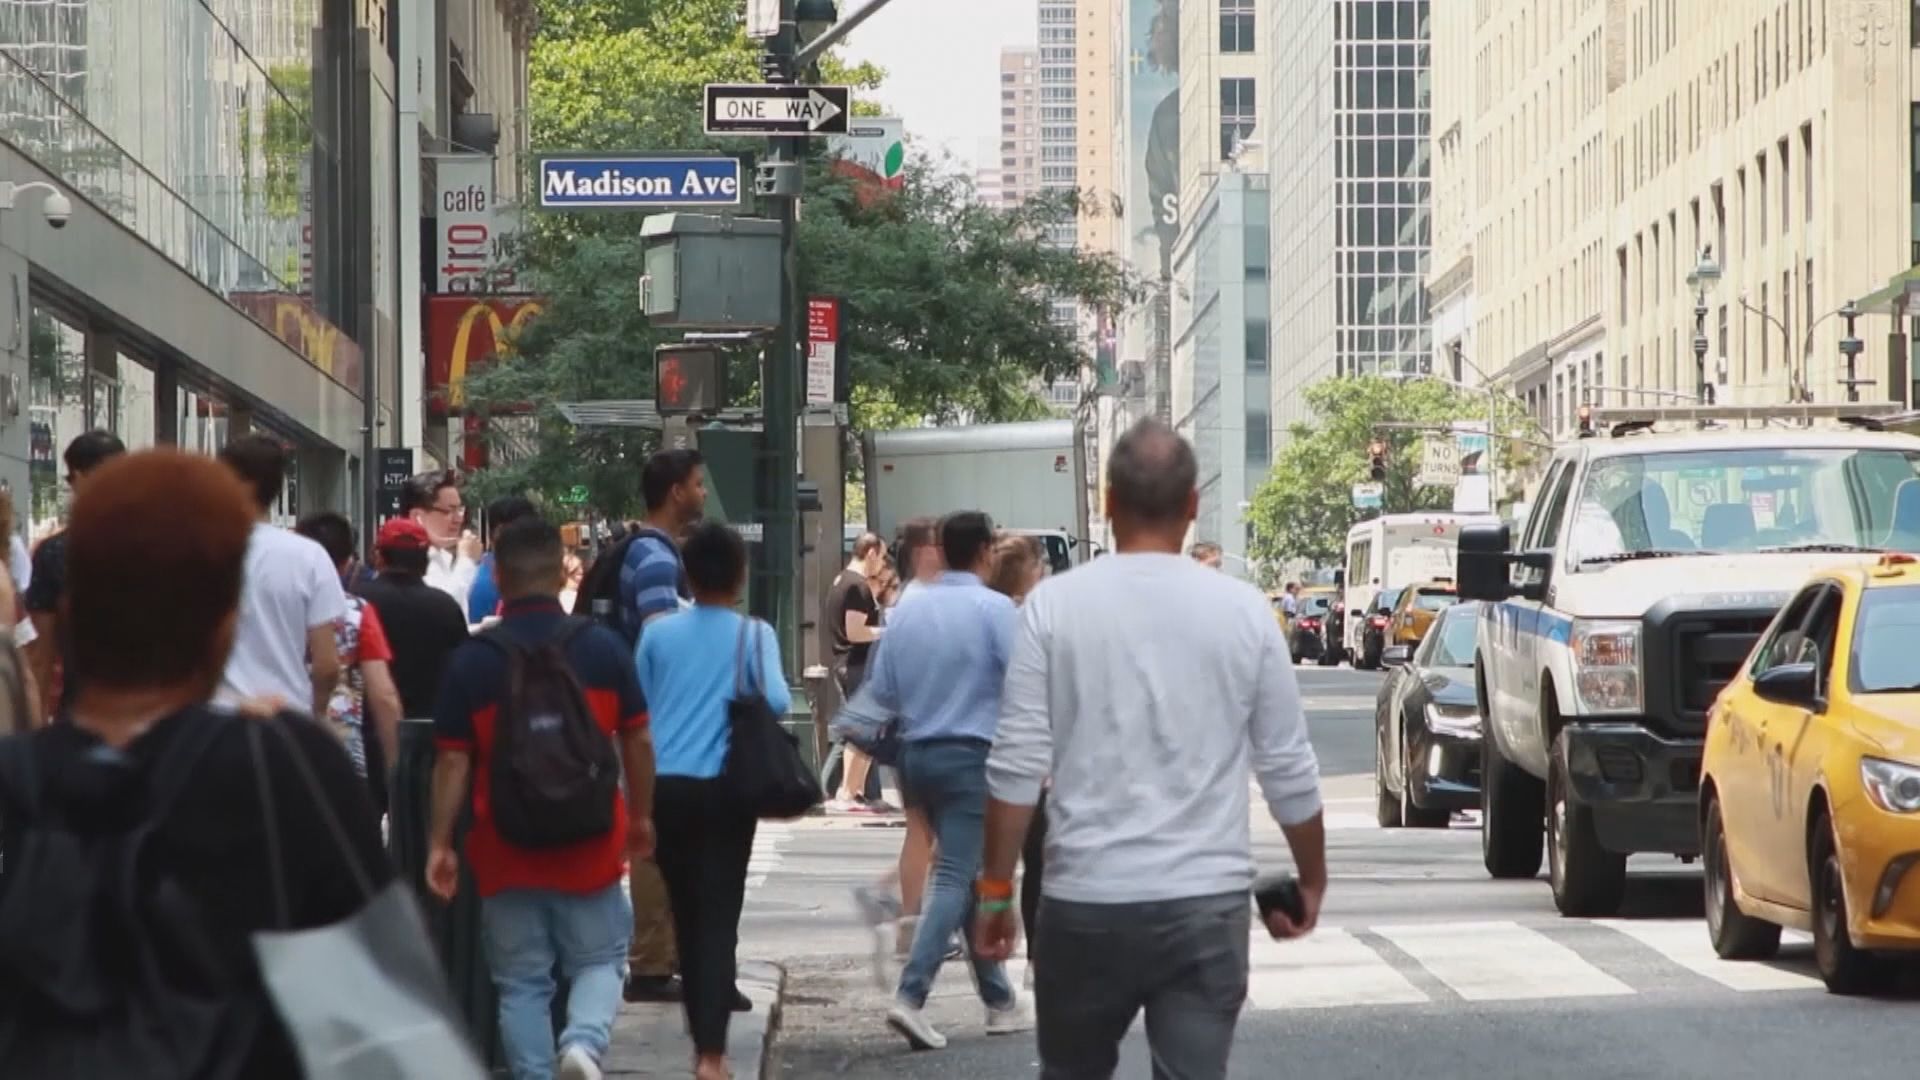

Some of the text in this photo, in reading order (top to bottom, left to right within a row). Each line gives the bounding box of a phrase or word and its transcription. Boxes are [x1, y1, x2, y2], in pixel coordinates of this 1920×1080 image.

[727, 100, 826, 119] ONE WAY
[545, 168, 737, 196] Madison Ave
[443, 184, 486, 213] café
[1432, 446, 1451, 460] NO
[1425, 462, 1458, 475] TURNS
